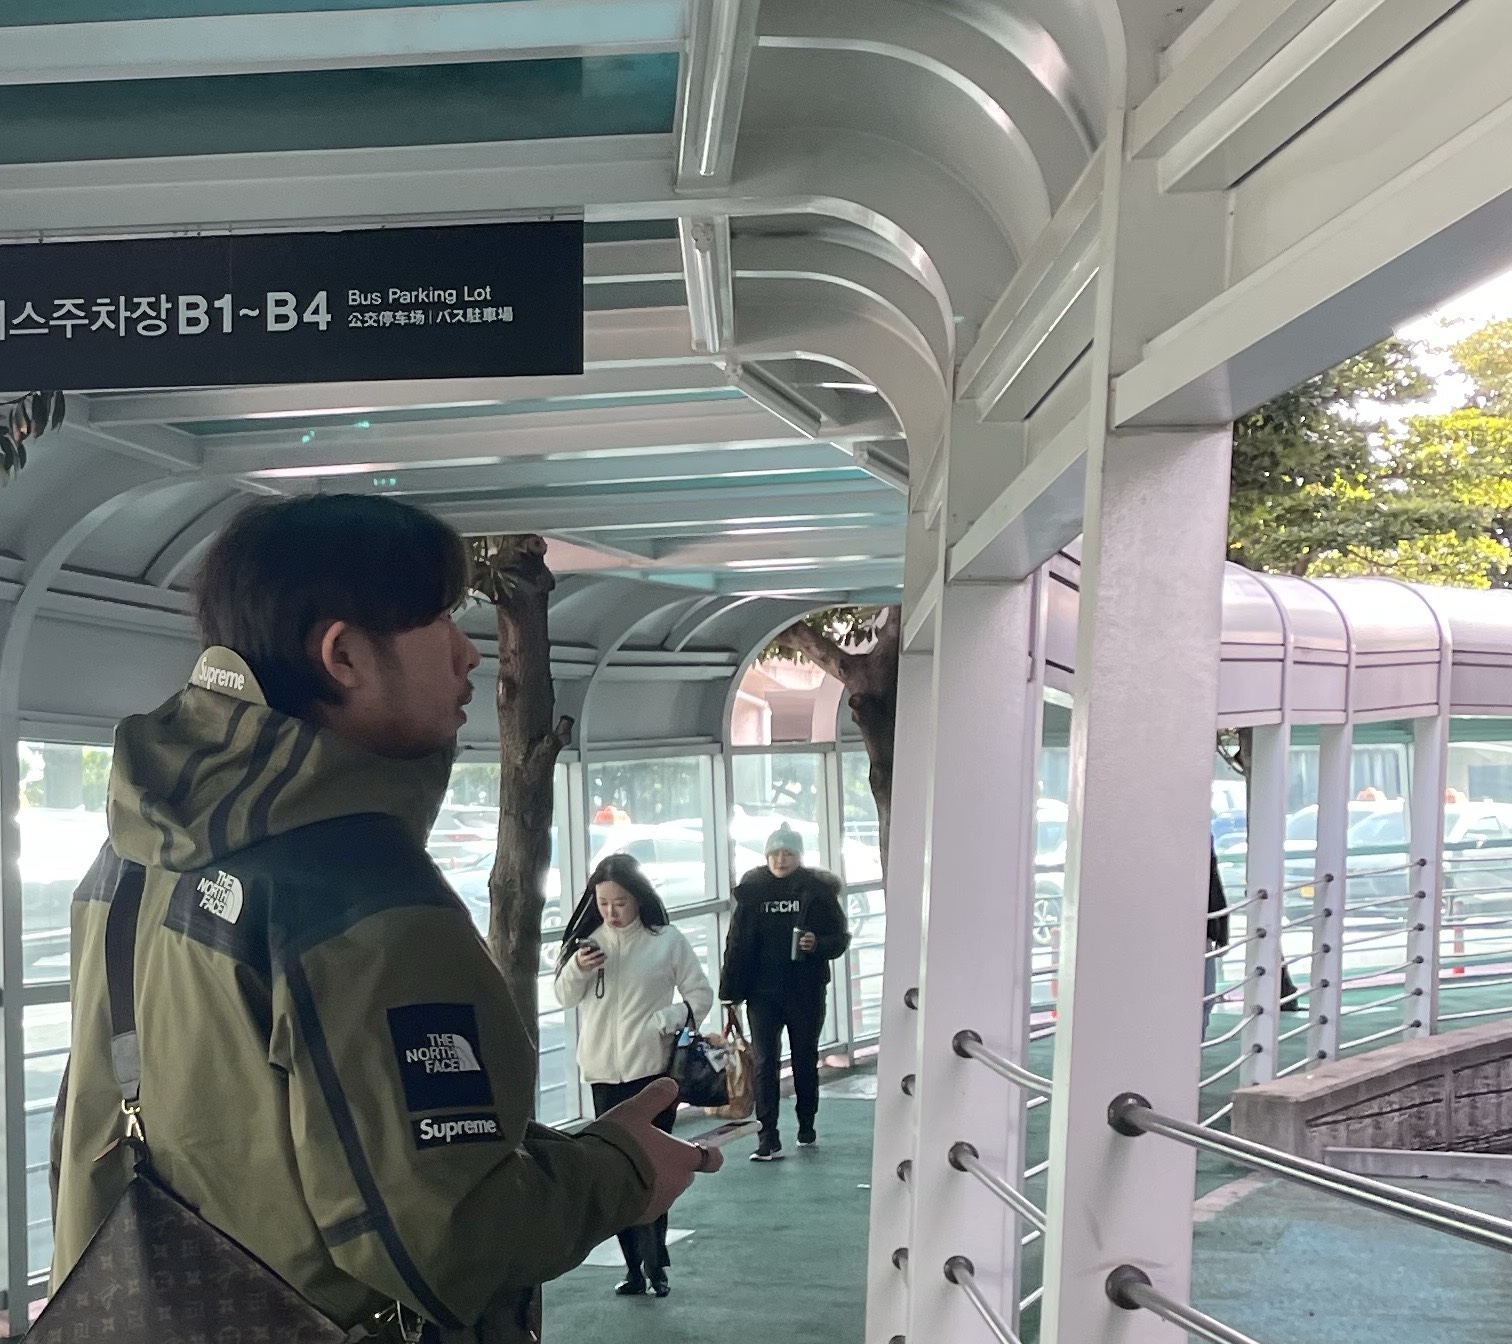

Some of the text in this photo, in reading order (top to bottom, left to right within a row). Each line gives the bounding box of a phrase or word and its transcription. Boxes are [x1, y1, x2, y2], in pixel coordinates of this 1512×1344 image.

[348, 285, 492, 306] Bus Parking Lot
[348, 309, 425, 327] 公交停车场
[436, 306, 514, 323] バス駐車場
[199, 656, 245, 691] Supreme
[216, 870, 235, 890] THE
[427, 1033, 454, 1047] THE
[406, 1046, 459, 1063] NORTH
[425, 1059, 460, 1073] FACE
[420, 1119, 497, 1142] Supreme
